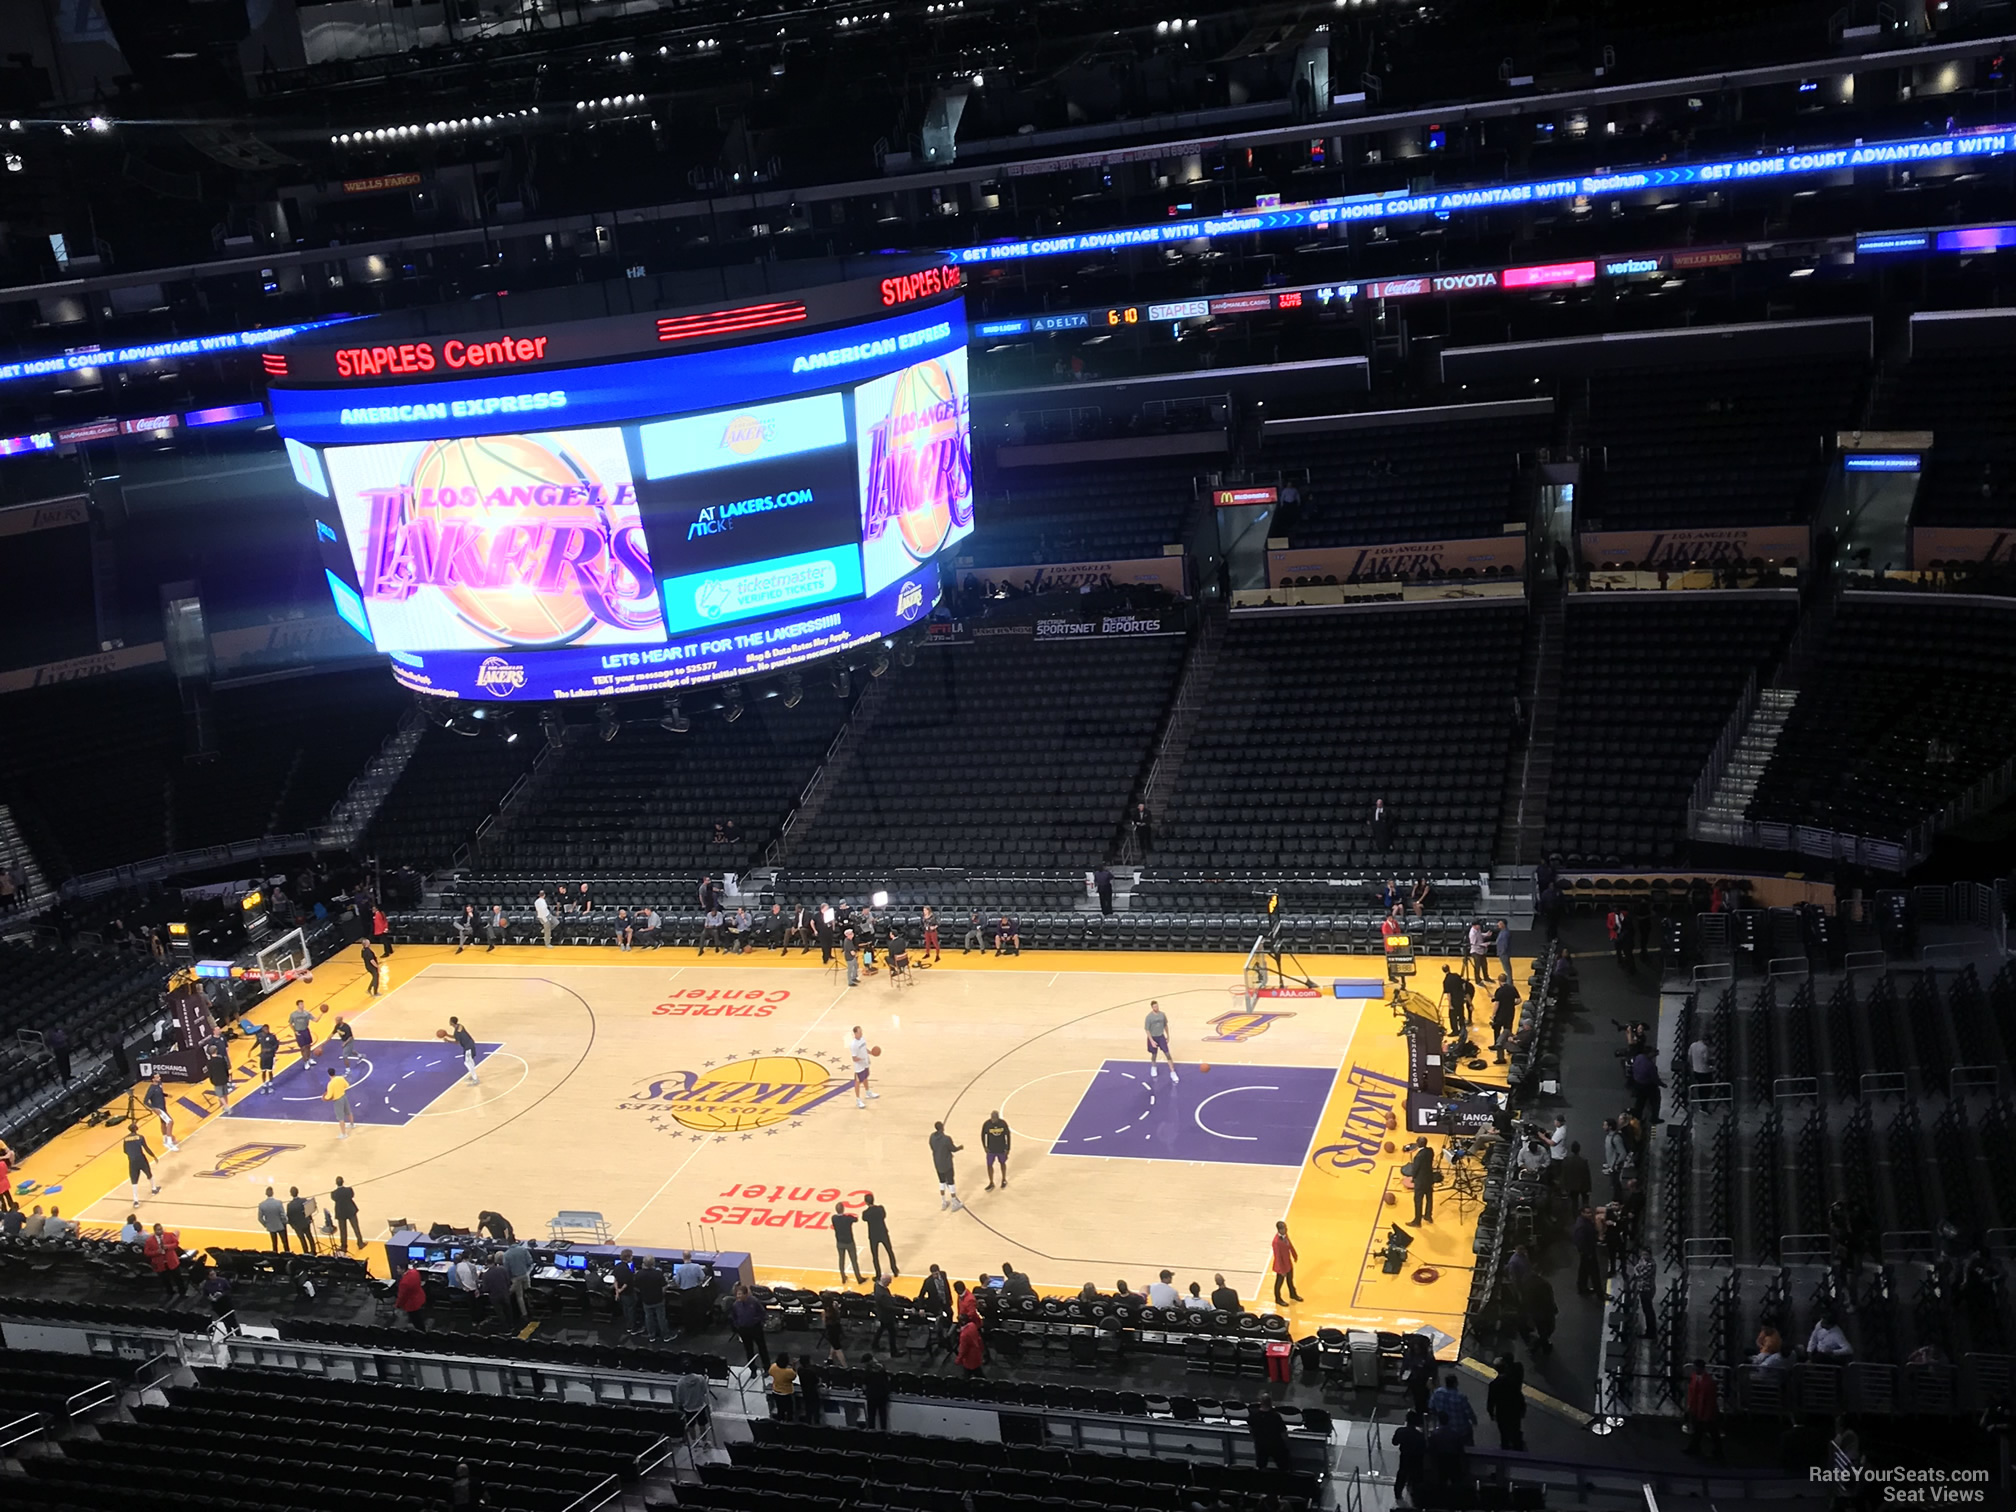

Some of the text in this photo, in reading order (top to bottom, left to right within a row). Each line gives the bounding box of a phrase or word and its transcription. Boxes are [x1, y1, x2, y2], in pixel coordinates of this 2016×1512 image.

[1701, 135, 2006, 180] GET HOME COURT ADVANTAGE WITH
[344, 174, 420, 192] WELLS FARGO
[1309, 173, 1646, 224] GET HOME COURT ADVANTAGE WITH Spectrum
[962, 216, 1262, 262] GET HOME COURT ADVANTAGE WITH Spectrum
[1607, 258, 1658, 275] verizon
[881, 267, 941, 307] STAPLES
[1434, 273, 1497, 291] TOYOTA
[1279, 293, 1302, 301] TIME
[1279, 300, 1302, 308] OUTS
[1047, 316, 1088, 329] DELTA
[1151, 302, 1207, 319] STAPLES
[24, 360, 65, 374] HOME
[68, 352, 115, 368] COURT
[119, 340, 199, 362] ADVANTAGE
[201, 335, 236, 350] WITH
[336, 336, 547, 377] STAPLES Center
[792, 321, 951, 374] AMERICAN EXPRESS
[340, 390, 568, 425] AMERICAN EXPRESS
[863, 414, 974, 542] LAKERS
[419, 486, 480, 509] LOS
[698, 488, 814, 523] AT LAKERS.COM
[355, 486, 665, 631] LAKERS
[1645, 533, 1747, 564] LAKERS
[1350, 550, 1444, 578] LAKERS
[737, 565, 828, 595] ticketmaster
[737, 580, 826, 606] VERIFIED TICKETS
[951, 622, 964, 633] LA
[1036, 619, 1161, 636] SPORTSNET DEPORTES
[602, 652, 640, 669] LETS
[642, 646, 684, 665] HEAR
[684, 643, 698, 657] IT
[700, 638, 733, 656] FOR
[734, 631, 764, 650] THE
[475, 665, 529, 688] LAKERS
[686, 660, 718, 674] 525377
[668, 988, 791, 1004] Center
[1279, 989, 1317, 998] AAA.com
[652, 1003, 778, 1018] STAPLES
[153, 1064, 188, 1073] PECHANGA
[628, 1070, 864, 1116] LAKERS
[616, 1102, 774, 1115] LOS ANGELES
[1312, 1061, 1409, 1178] LAKERS
[719, 1183, 874, 1209] Center
